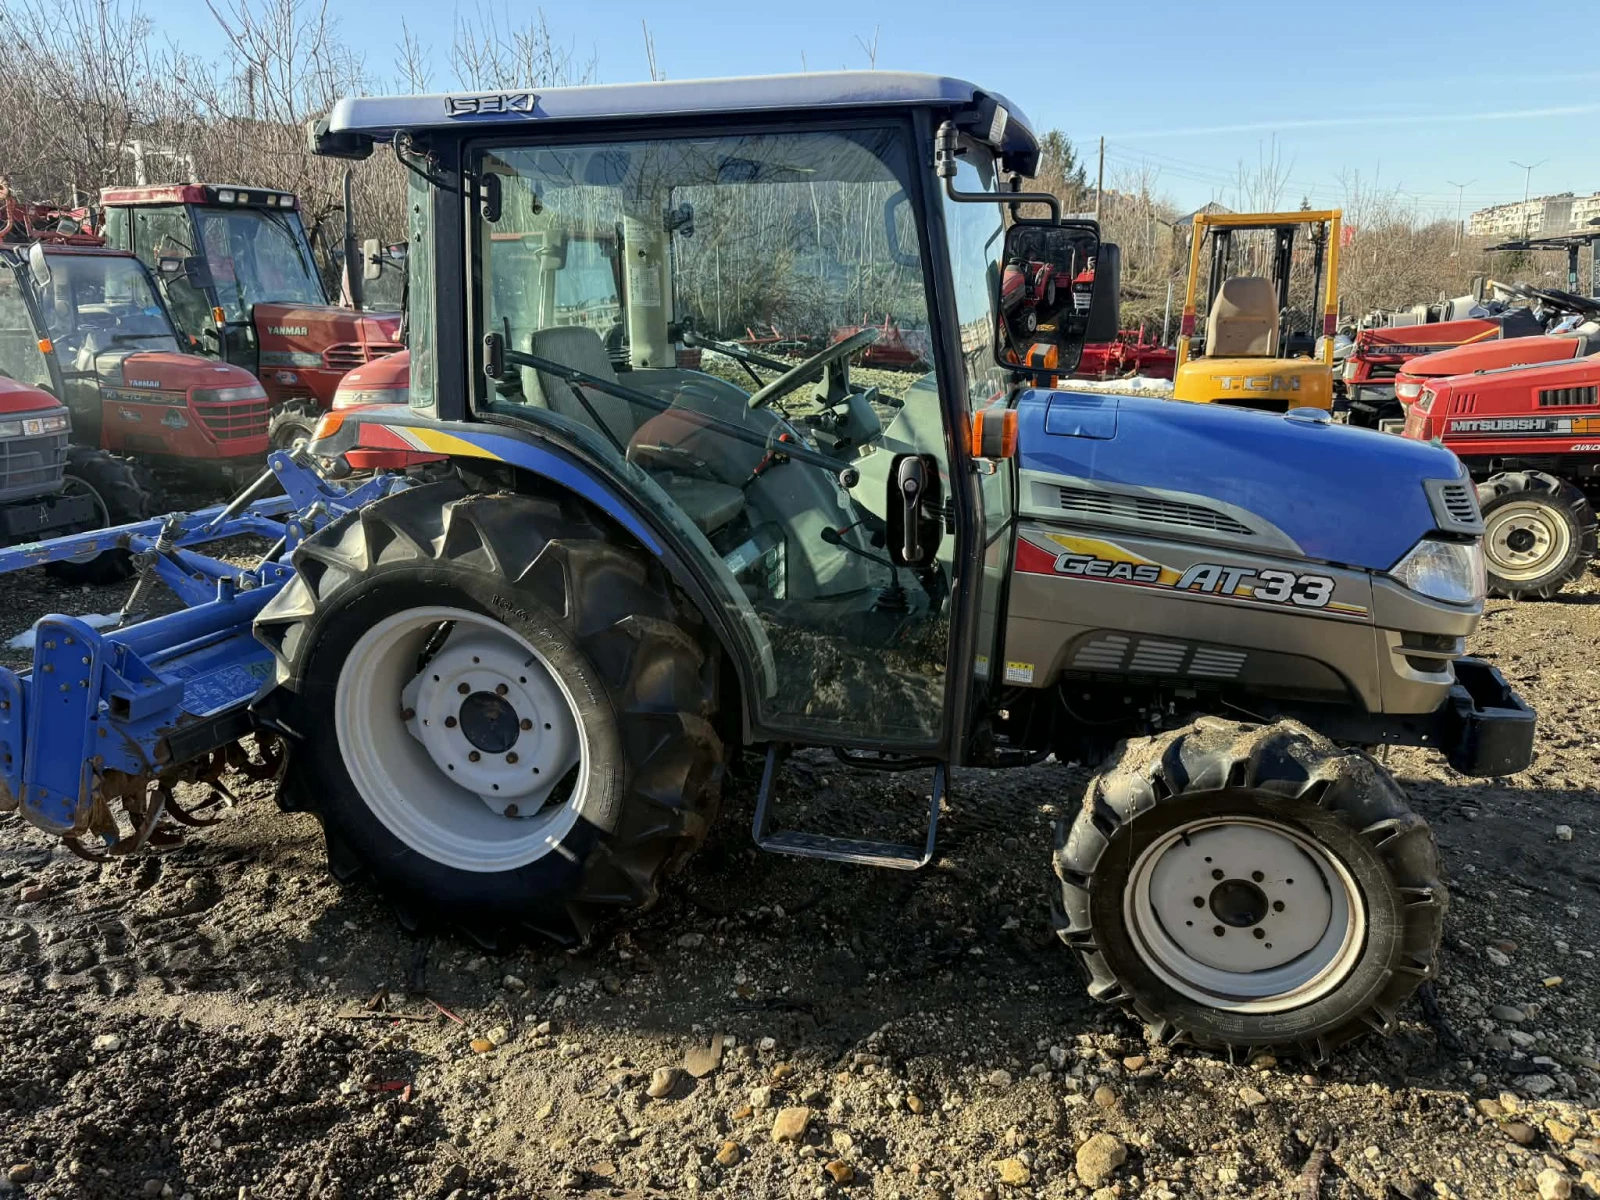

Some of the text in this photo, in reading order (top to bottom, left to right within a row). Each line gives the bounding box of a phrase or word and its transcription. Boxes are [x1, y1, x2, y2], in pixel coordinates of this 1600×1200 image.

[444, 93, 535, 117] ISEKI
[267, 326, 308, 336] YANMAR
[128, 379, 160, 388] YANMAR
[1210, 374, 1301, 391] TCM
[1450, 418, 1546, 432] MITSUBISHI
[1175, 562, 1258, 596] AT
[1252, 568, 1336, 609] 33
